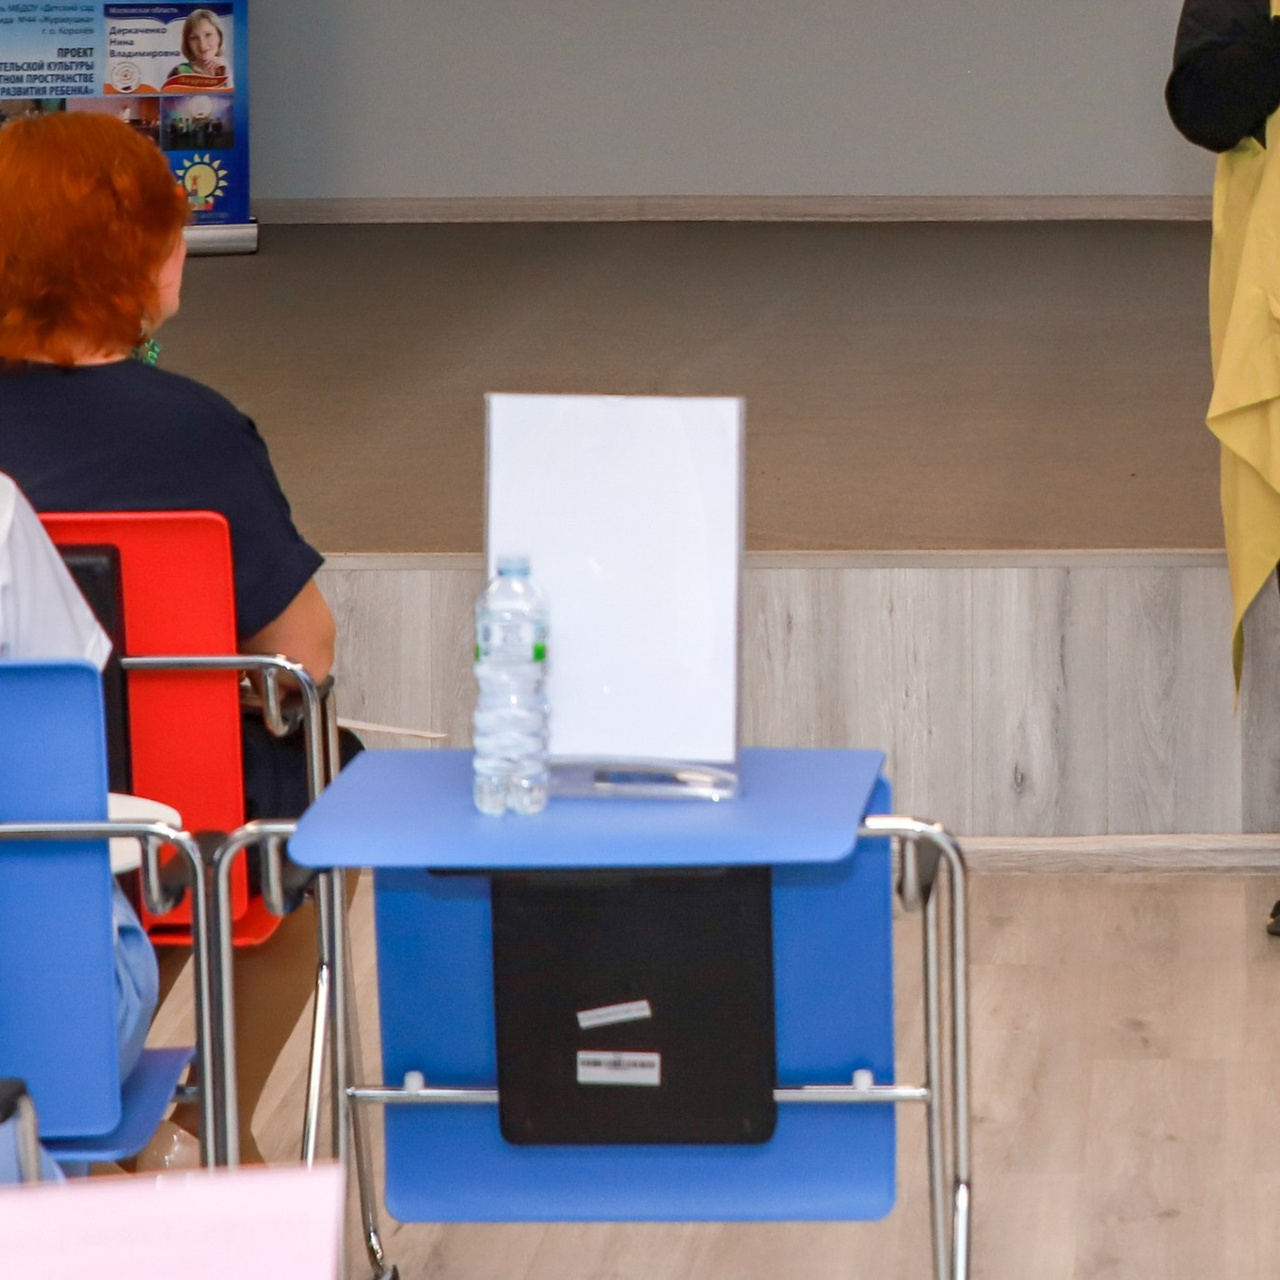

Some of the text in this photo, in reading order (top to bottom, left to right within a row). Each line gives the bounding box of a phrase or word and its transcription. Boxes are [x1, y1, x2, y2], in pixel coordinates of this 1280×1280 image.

[109, 26, 167, 36] Деркаченко
[109, 38, 134, 47] Нина
[57, 47, 95, 58] ПРОЕКТ
[109, 49, 181, 59] Владимировна
[47, 61, 95, 72] КУЛЬТУРЫ
[26, 73, 95, 84] ПРОСТРАНСТВЕ
[1, 86, 47, 96] РАЗВИТИЯ
